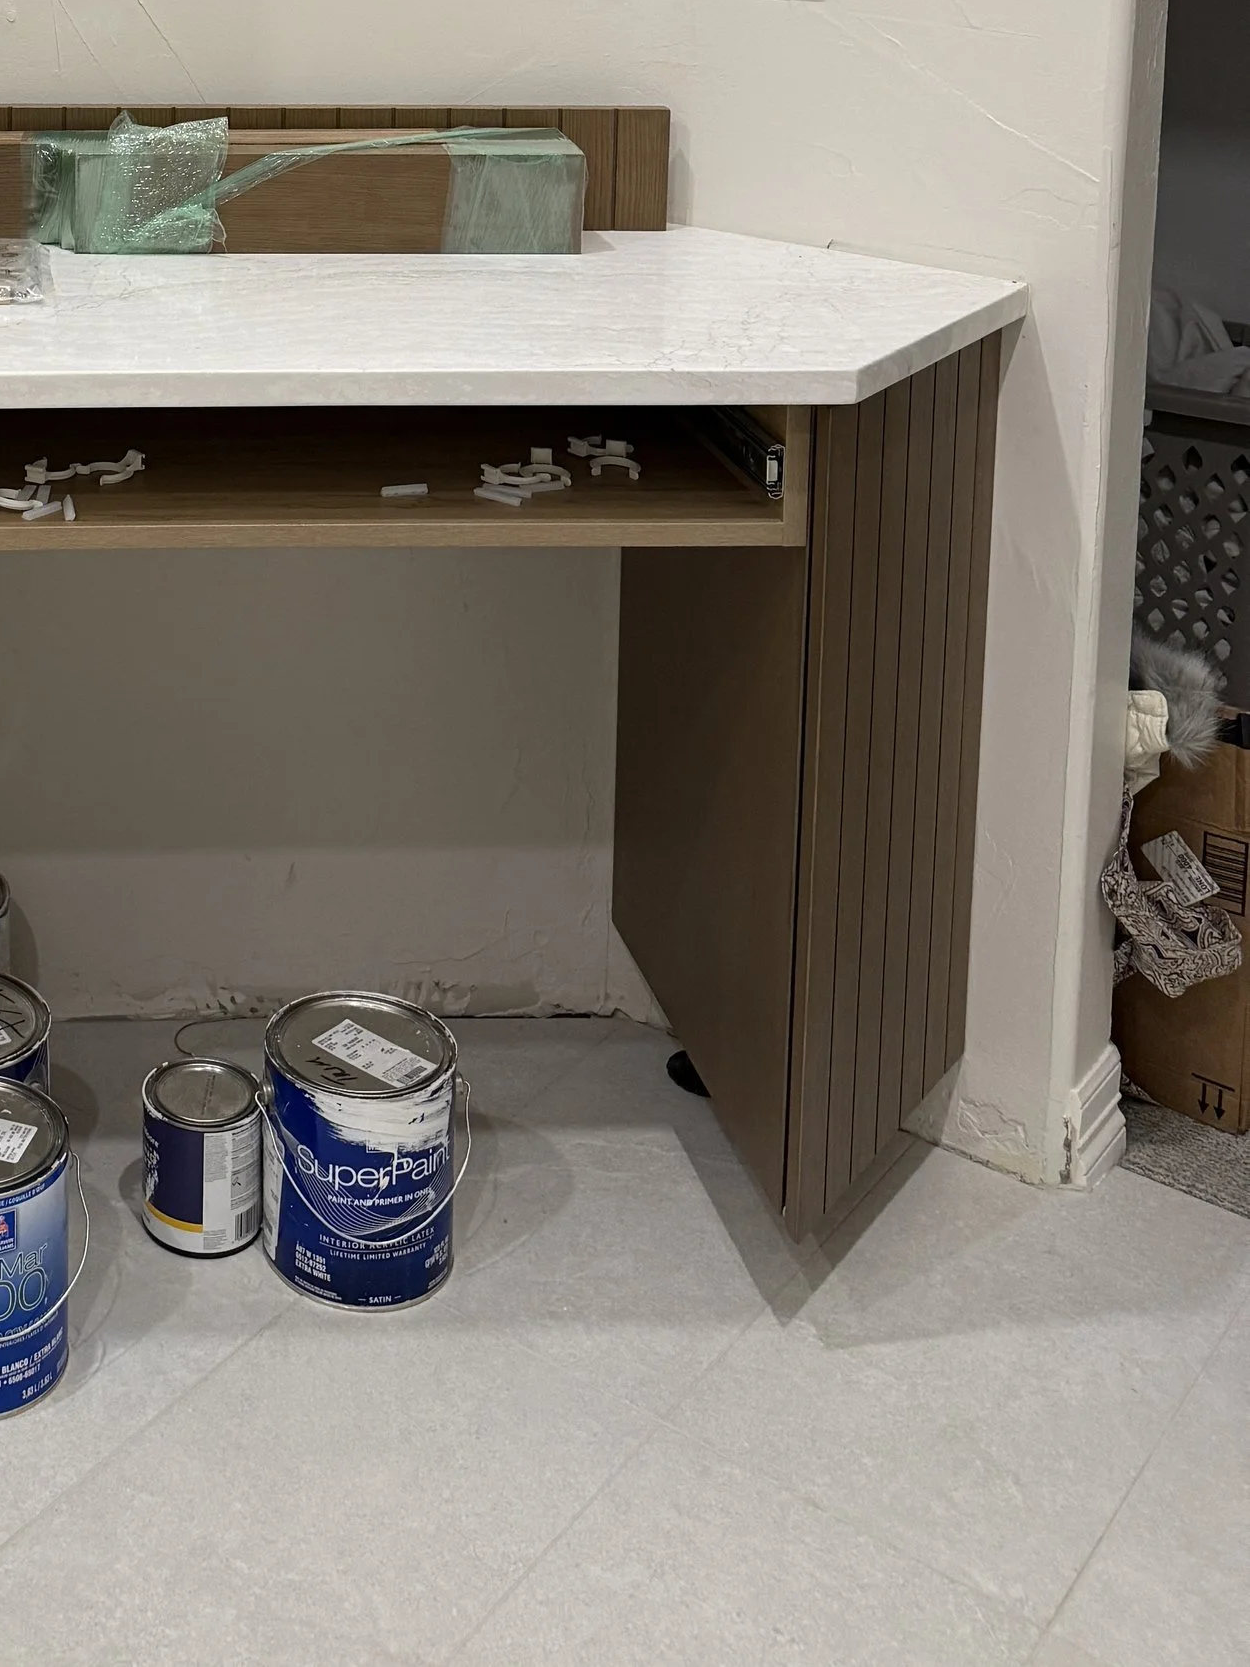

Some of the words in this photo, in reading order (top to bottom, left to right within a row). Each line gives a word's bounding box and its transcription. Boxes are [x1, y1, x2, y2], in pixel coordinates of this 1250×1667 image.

[297, 1135, 450, 1191] SuperPaint
[374, 1196, 403, 1206] PRIMER
[405, 1193, 413, 1202] IN
[319, 1233, 366, 1250] INTERIOR
[411, 1226, 435, 1242] LATEX
[330, 1249, 361, 1261] LIFETIME
[363, 1252, 391, 1261] LIMITED
[393, 1242, 427, 1258] WARRANTY
[369, 1295, 392, 1304] SATIN
[1, 1357, 29, 1375] BLANCO
